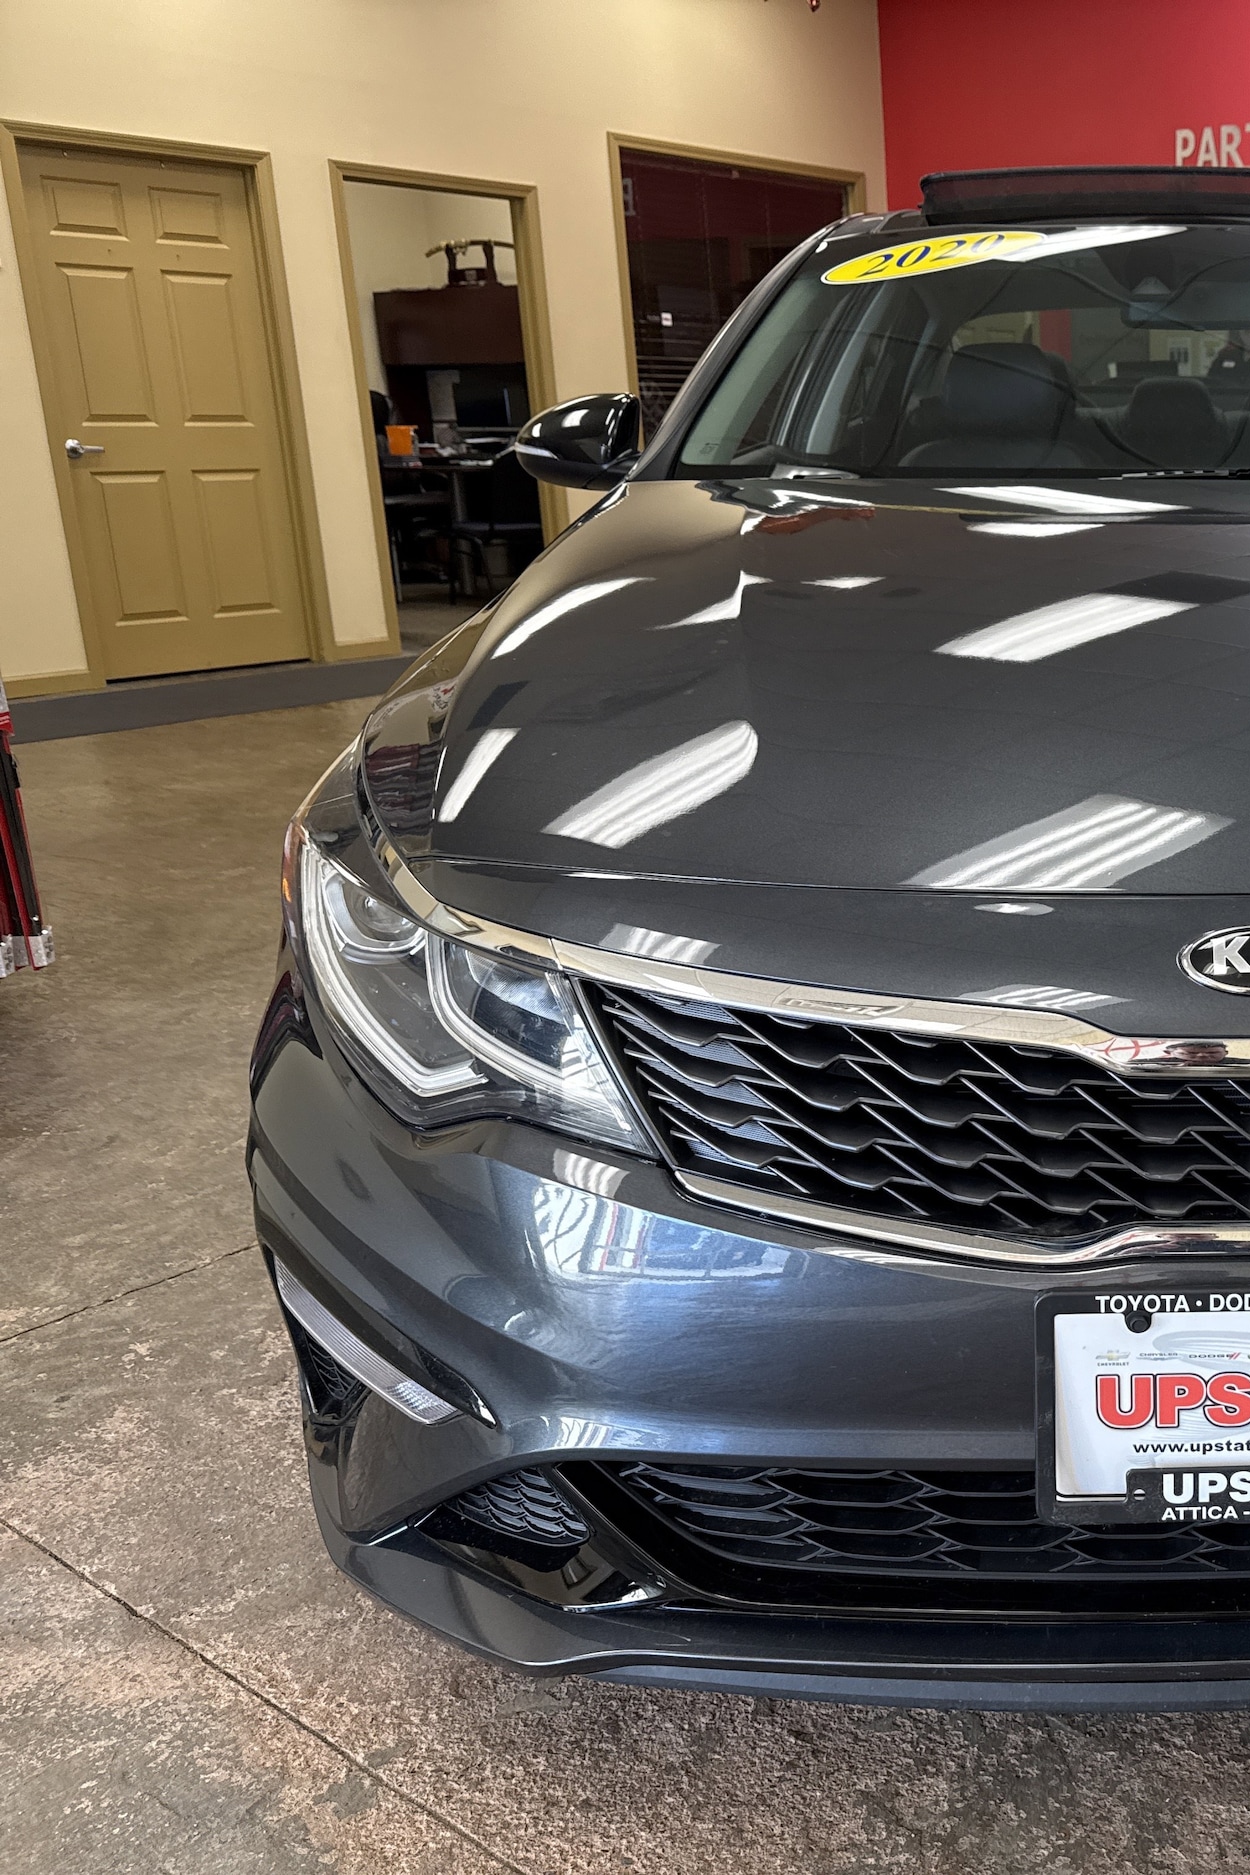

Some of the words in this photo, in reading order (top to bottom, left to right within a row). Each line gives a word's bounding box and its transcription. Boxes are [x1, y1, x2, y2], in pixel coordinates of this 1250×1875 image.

[856, 234, 1006, 279] 2020
[1095, 1294, 1190, 1313] TOYOTA
[1161, 1506, 1238, 1521] ATTICA
